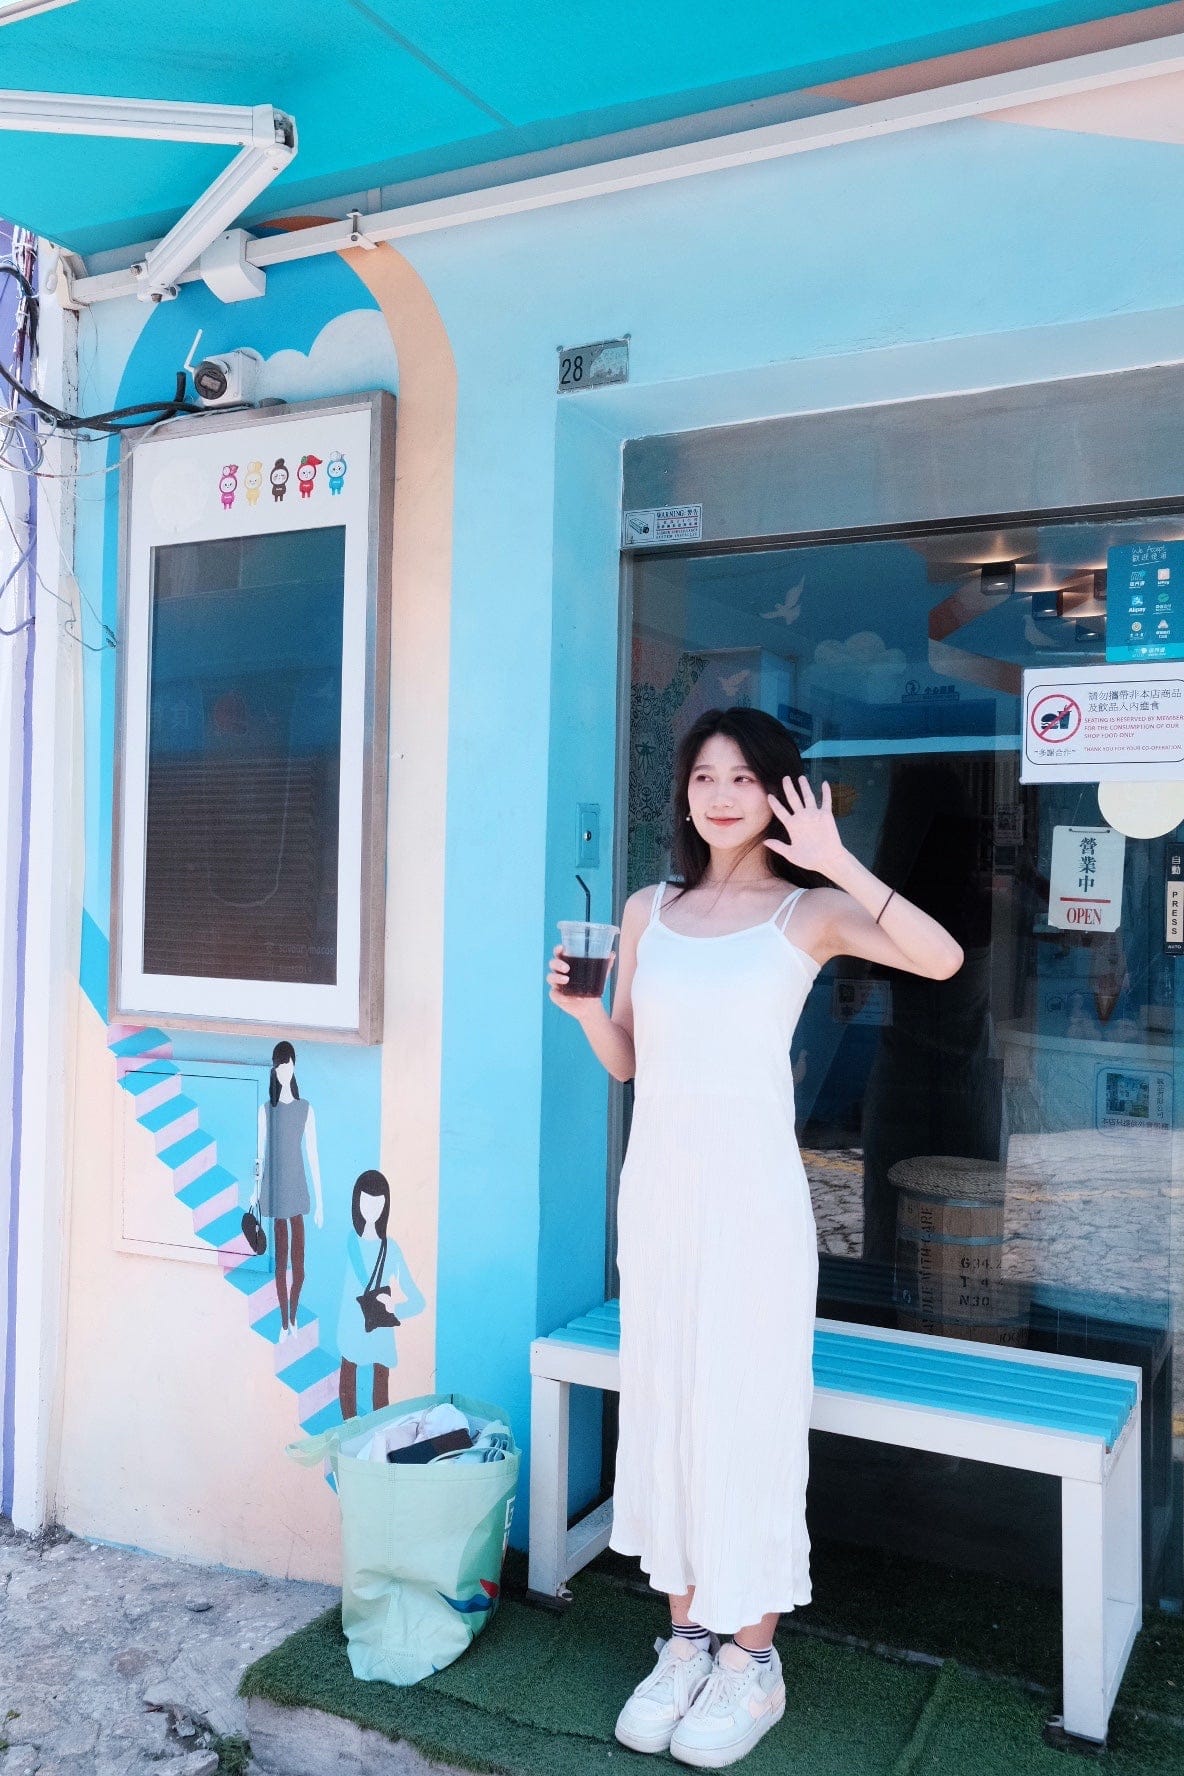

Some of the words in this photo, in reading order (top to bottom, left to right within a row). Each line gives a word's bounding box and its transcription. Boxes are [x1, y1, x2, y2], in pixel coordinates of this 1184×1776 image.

[561, 355, 583, 384] 28
[1078, 837, 1097, 893] 營業中
[1171, 855, 1181, 875] 自動
[1066, 907, 1102, 925] OPEN
